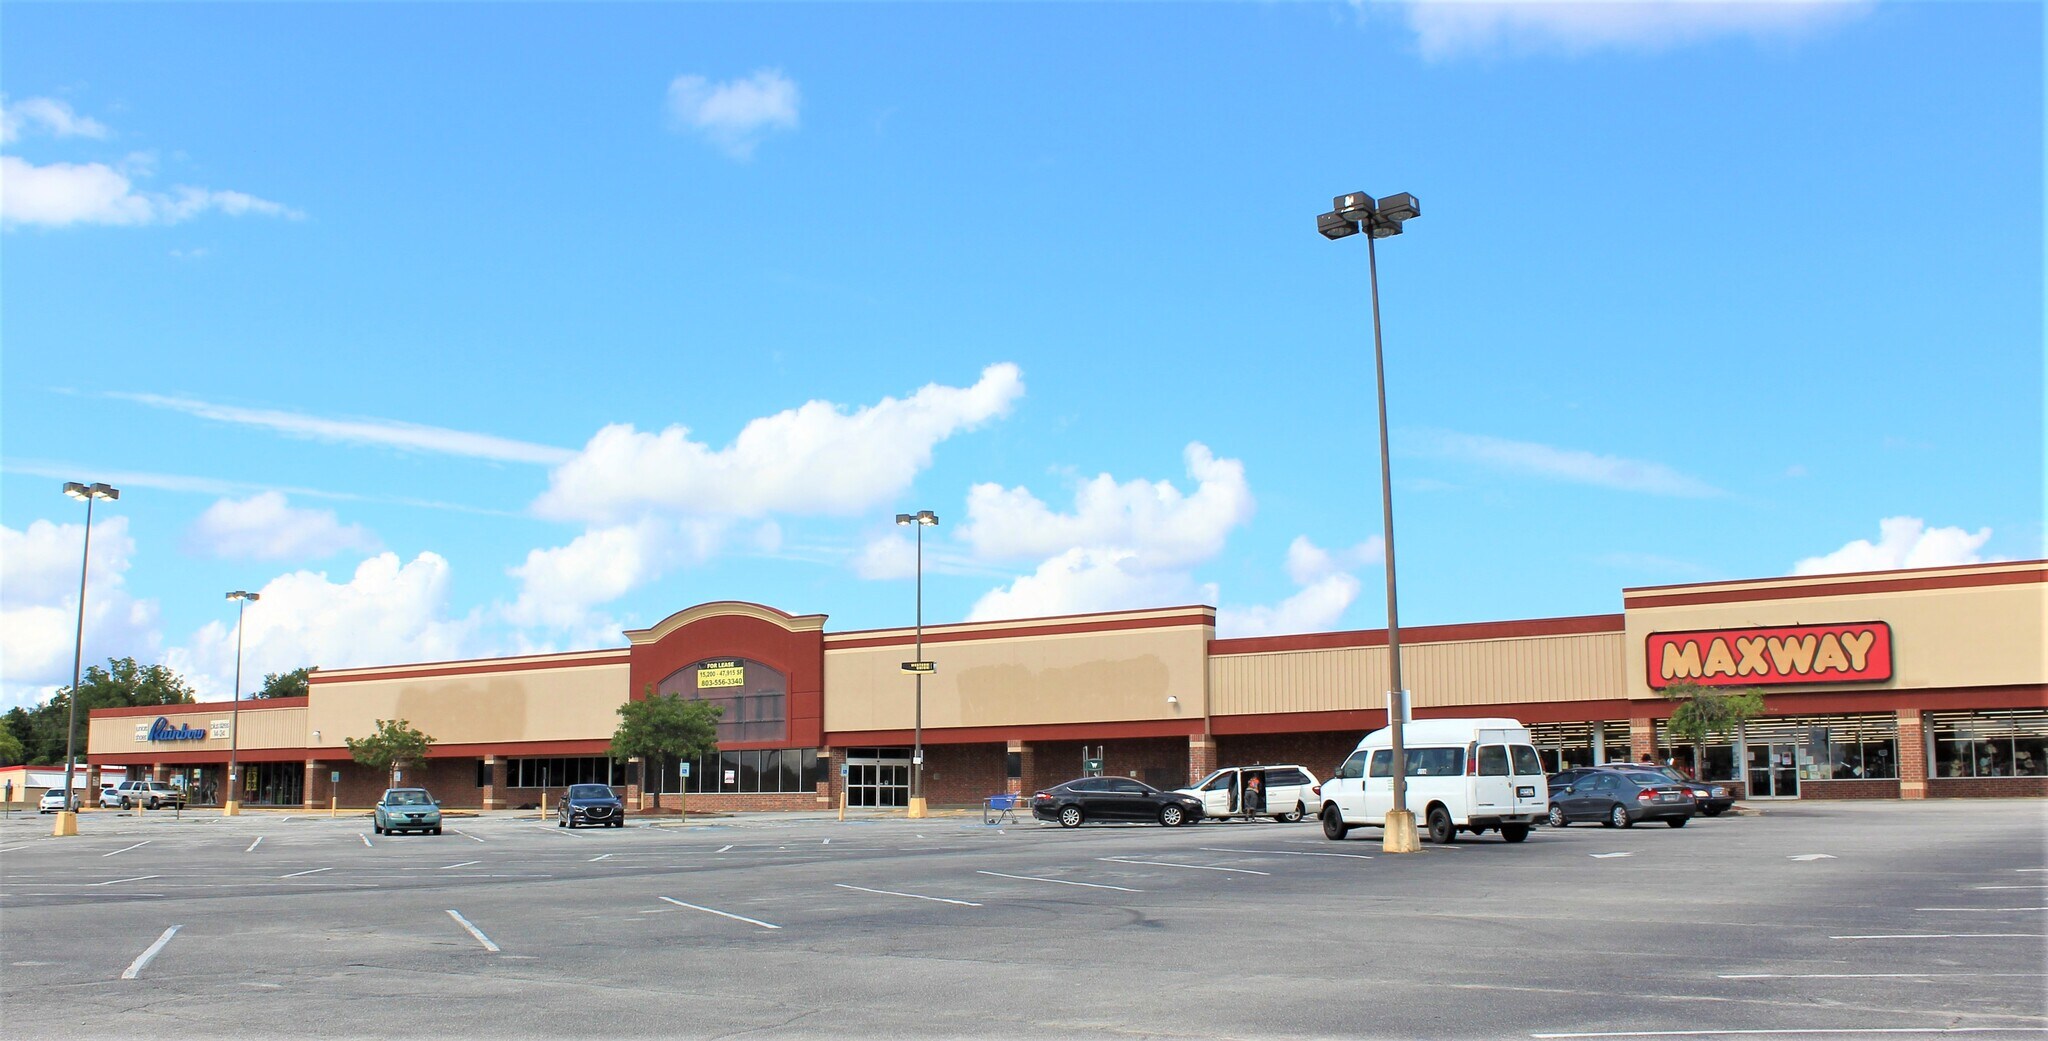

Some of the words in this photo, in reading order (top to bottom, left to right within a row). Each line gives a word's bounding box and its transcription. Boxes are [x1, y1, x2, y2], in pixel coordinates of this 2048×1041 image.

[1661, 630, 1875, 679] MAXWAY
[701, 678, 742, 686] 803-556-3340
[148, 716, 206, 740] Rainbow
